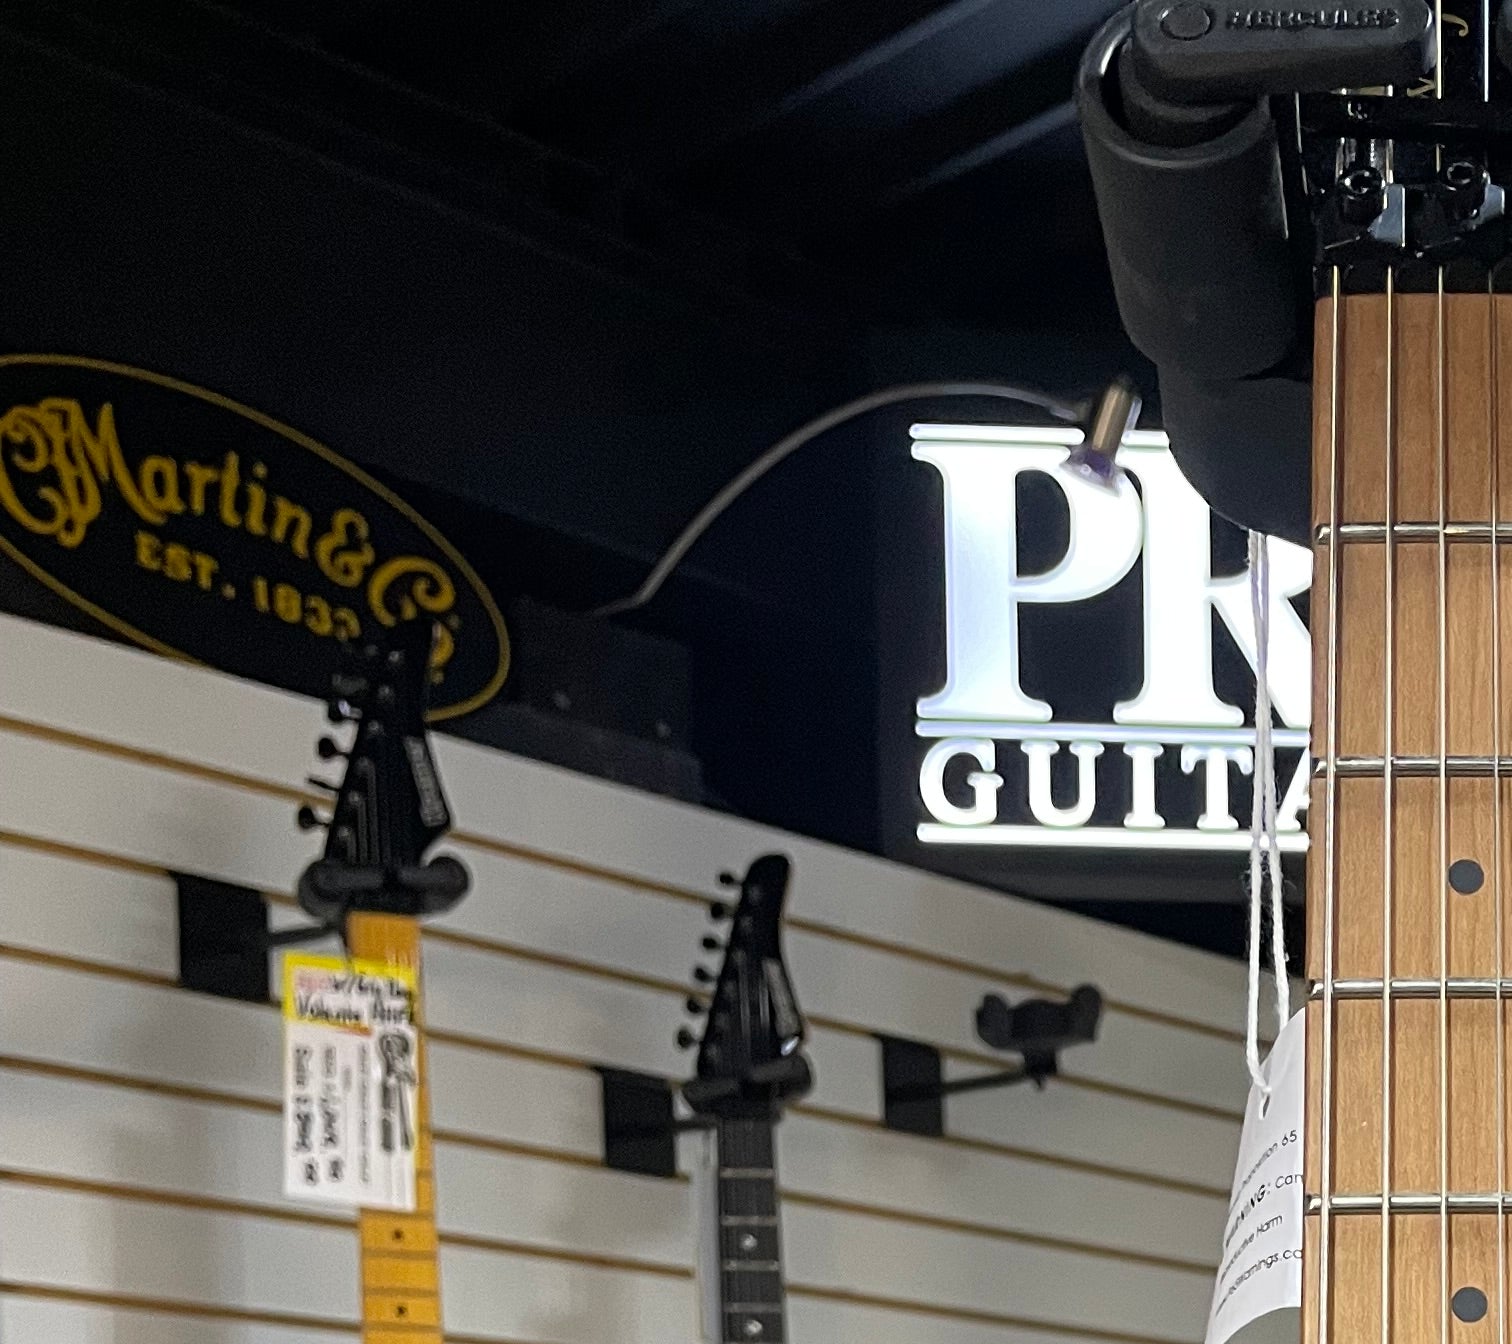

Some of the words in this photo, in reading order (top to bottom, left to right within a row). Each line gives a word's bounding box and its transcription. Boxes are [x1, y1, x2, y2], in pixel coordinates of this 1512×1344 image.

[57, 397, 311, 559] Martin
[315, 508, 375, 588] &
[911, 438, 1312, 726] PR
[918, 738, 1311, 830] GUIT
[1281, 1129, 1297, 1147] 65
